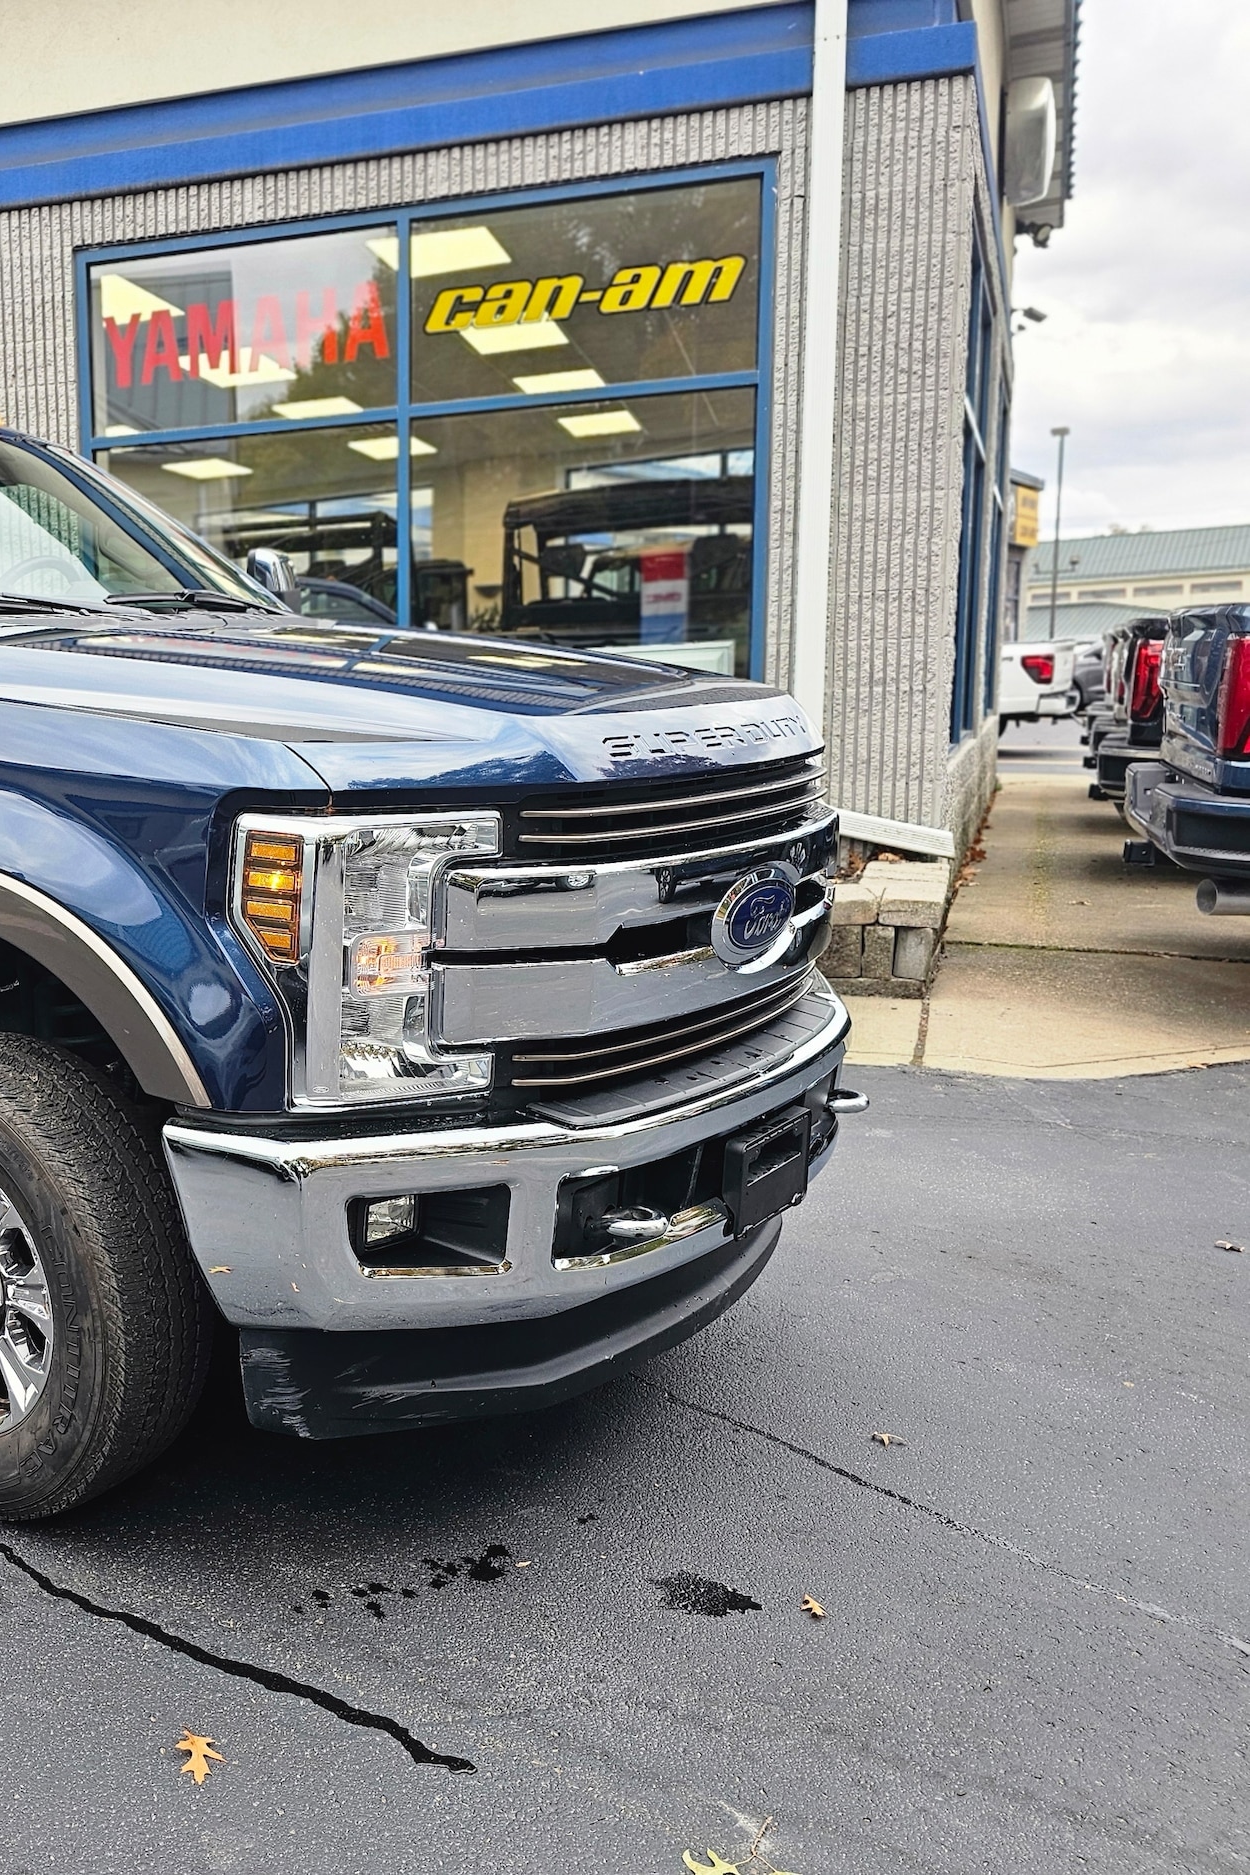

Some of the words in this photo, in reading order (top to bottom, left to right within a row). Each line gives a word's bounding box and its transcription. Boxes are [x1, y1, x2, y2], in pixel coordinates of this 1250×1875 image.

[424, 256, 747, 334] can-am
[102, 280, 390, 389] YAMAHA
[602, 727, 749, 760] SUPER
[740, 715, 807, 746] DUTY
[743, 894, 790, 940] Ford
